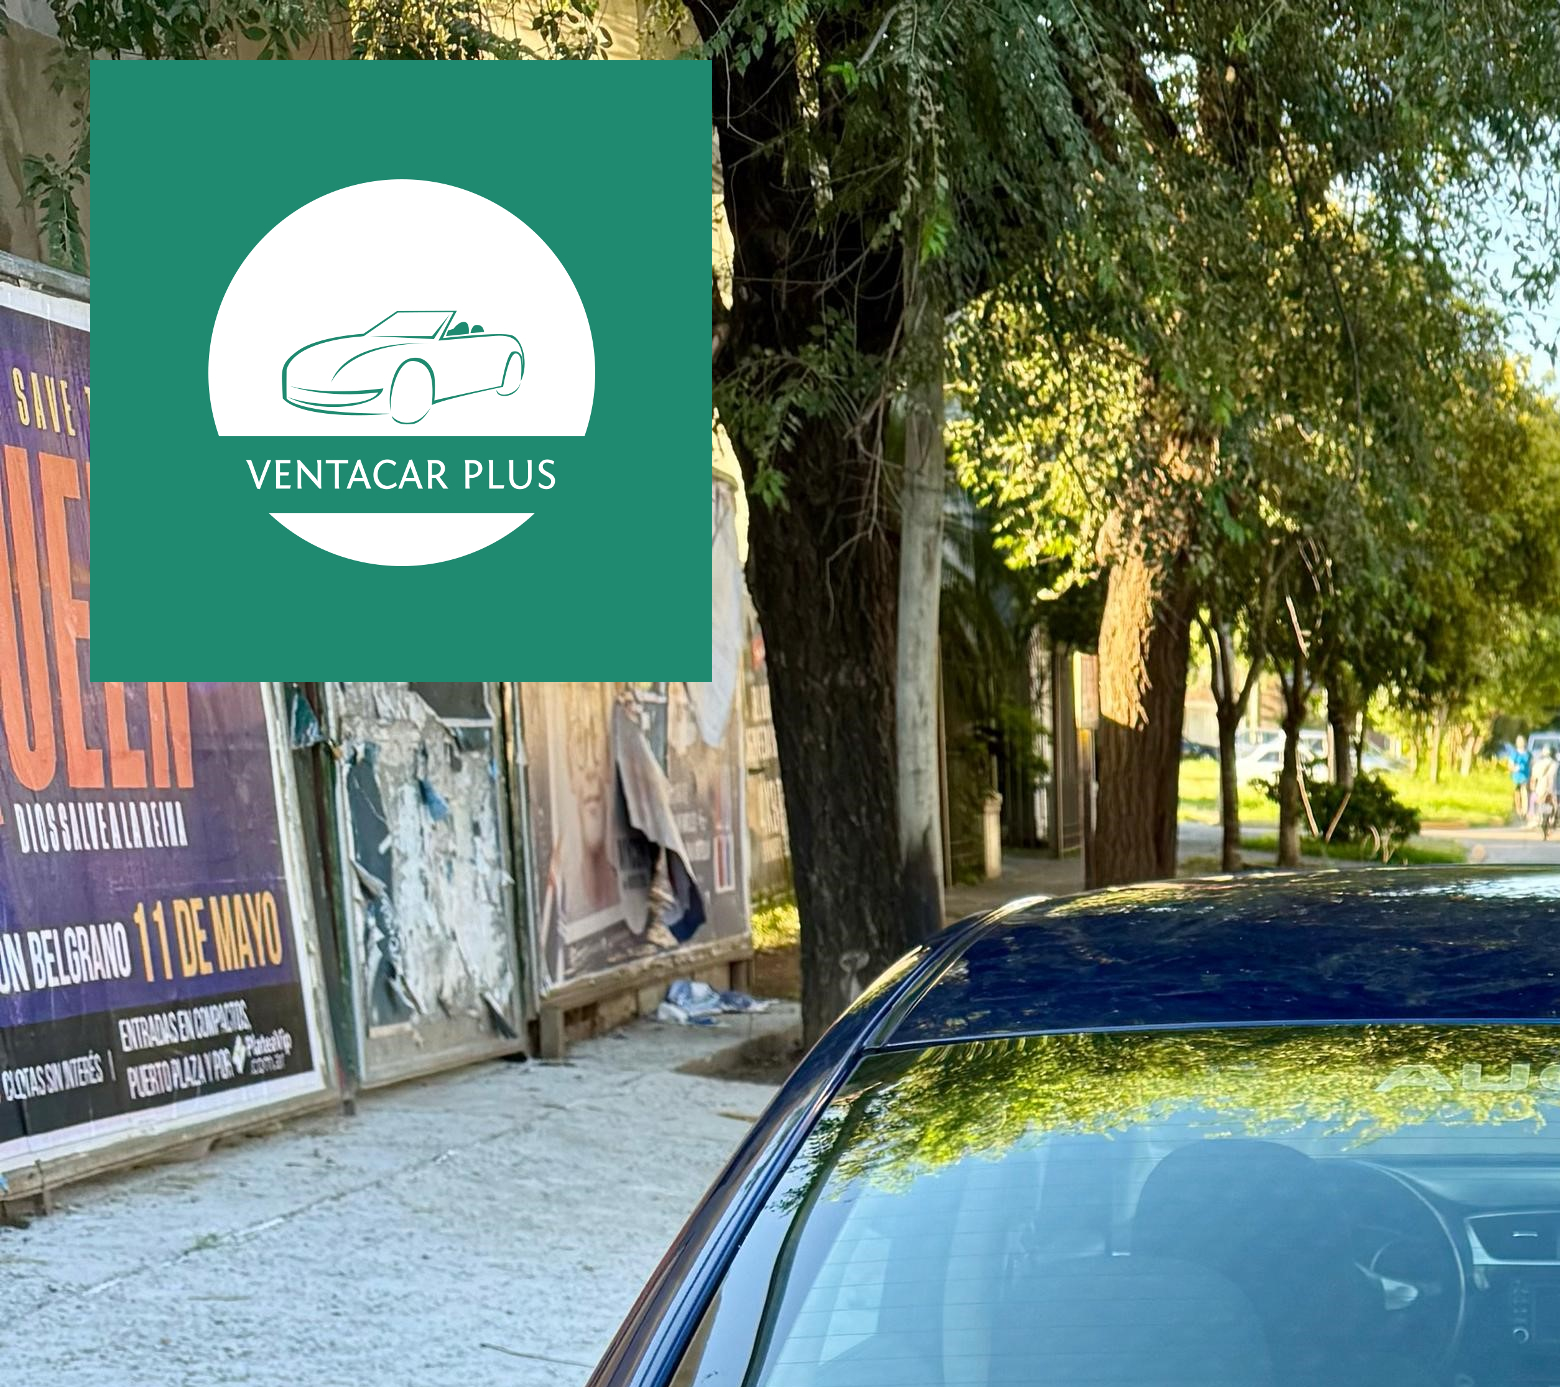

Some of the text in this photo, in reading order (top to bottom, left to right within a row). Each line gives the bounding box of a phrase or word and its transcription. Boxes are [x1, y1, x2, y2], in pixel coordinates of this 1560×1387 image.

[12, 367, 76, 436] SAVE
[27, 921, 131, 990] BELGRANO
[133, 900, 173, 982] 11
[172, 897, 213, 978] DE
[209, 890, 283, 972] MAYO
[118, 1011, 179, 1052] ENTRADAS
[176, 1009, 195, 1042] EN
[126, 1060, 173, 1099] PUERTO
[170, 1054, 207, 1089] PLAZA
